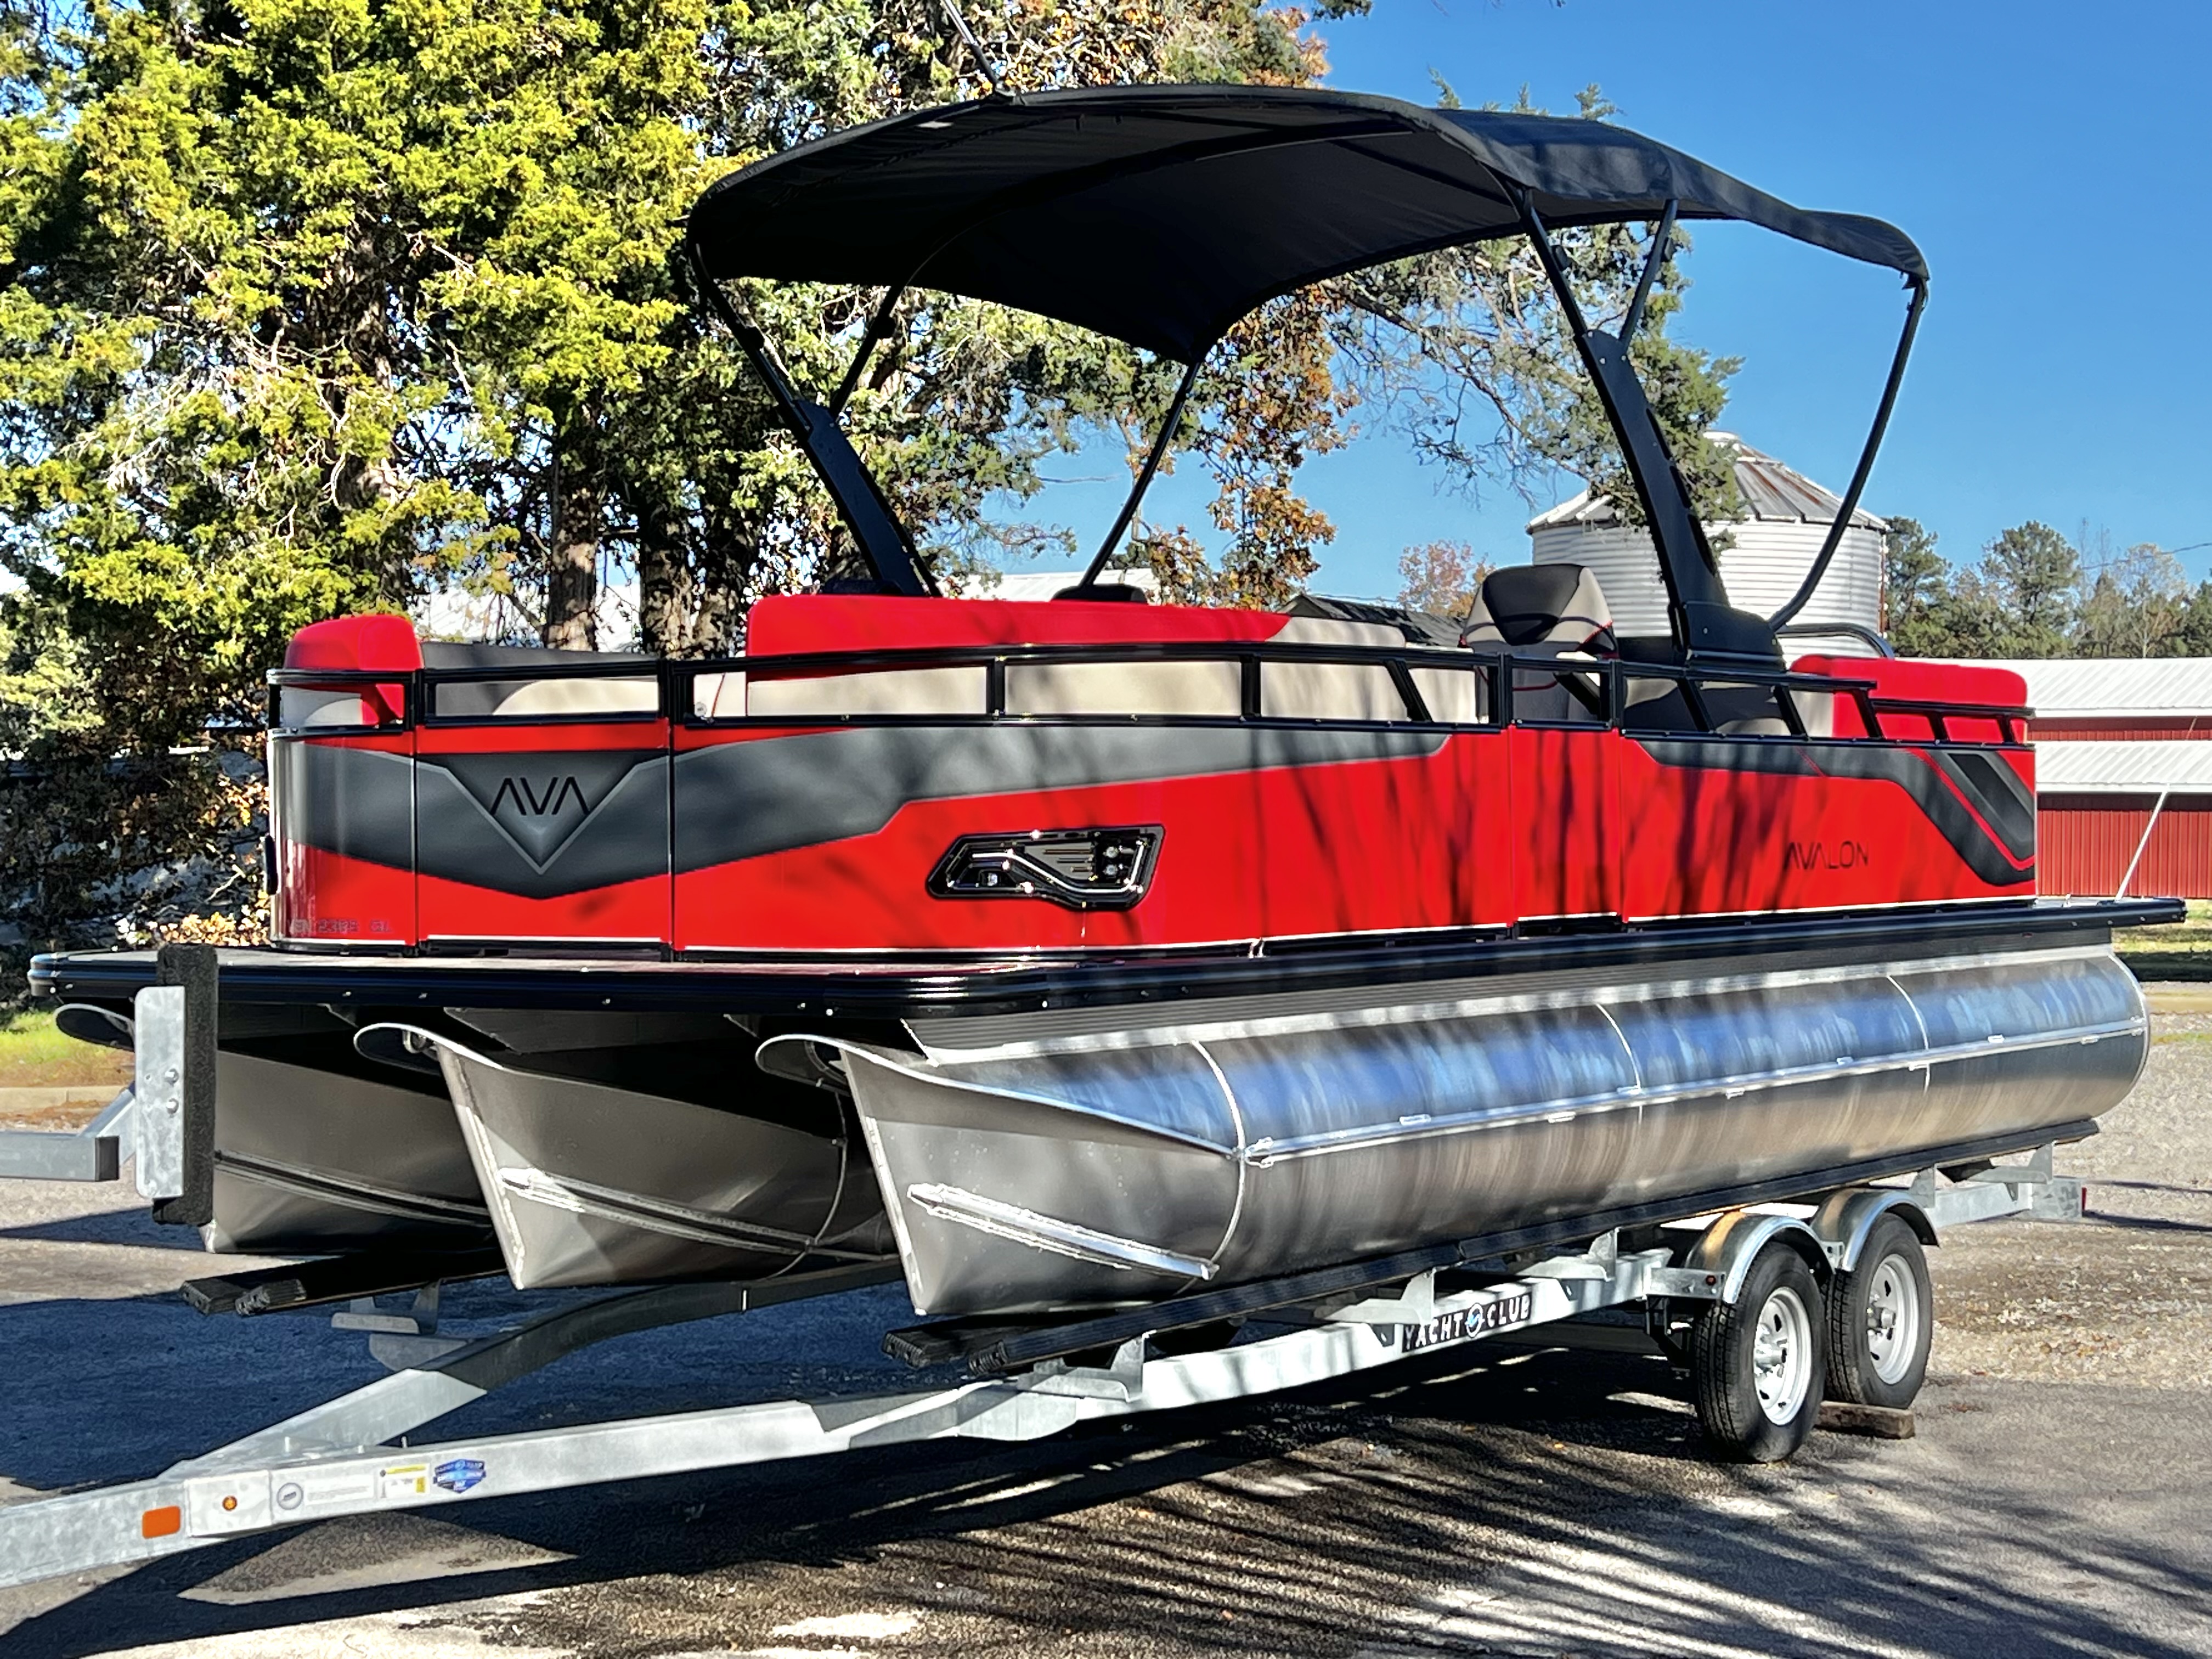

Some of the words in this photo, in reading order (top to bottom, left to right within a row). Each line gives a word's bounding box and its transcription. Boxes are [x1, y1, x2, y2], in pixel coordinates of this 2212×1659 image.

[490, 776, 591, 816] AVA
[1782, 840, 1870, 870] AVALON
[1404, 1312, 1464, 1350] YACHT
[1486, 1294, 1531, 1329] CLUB
